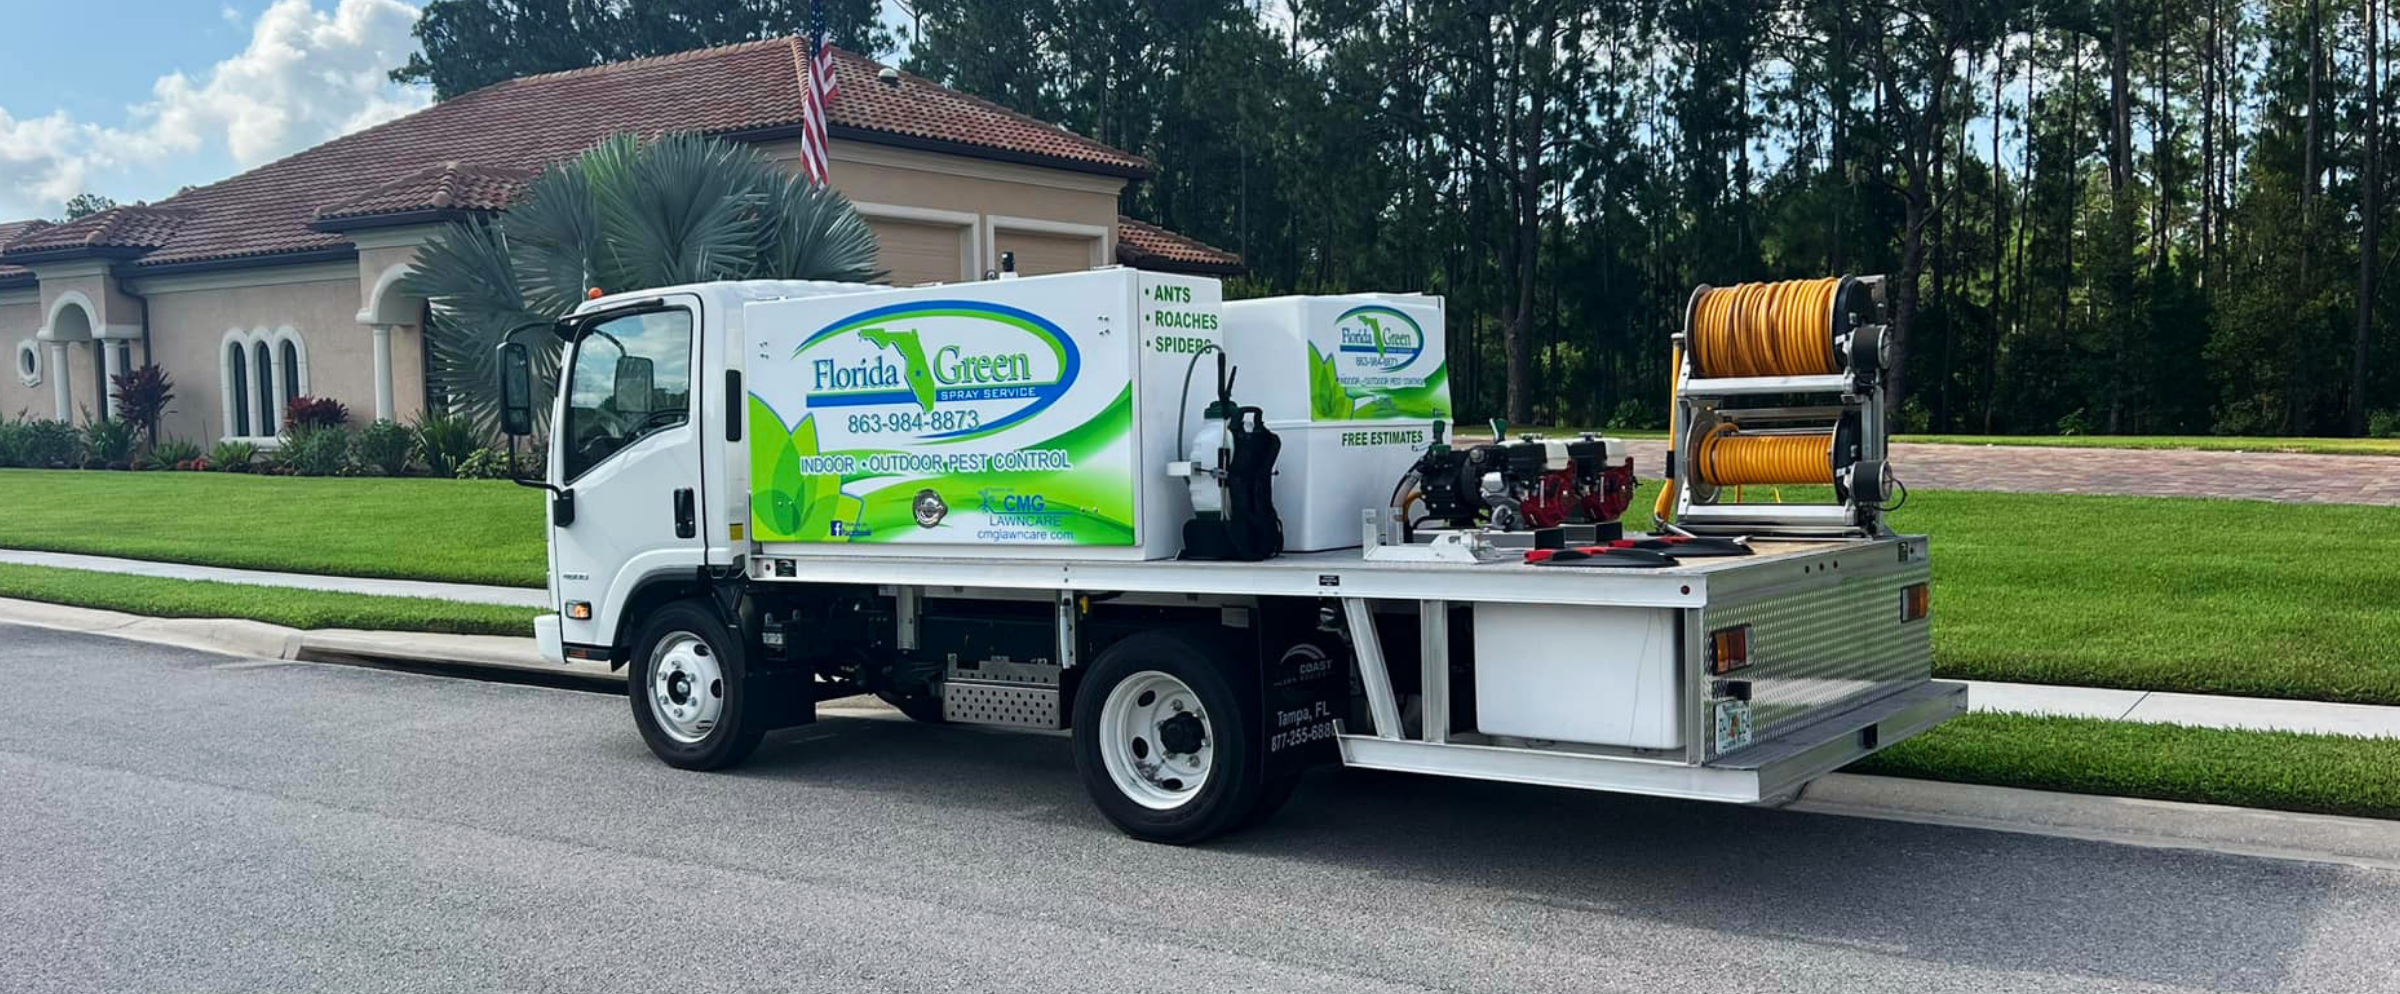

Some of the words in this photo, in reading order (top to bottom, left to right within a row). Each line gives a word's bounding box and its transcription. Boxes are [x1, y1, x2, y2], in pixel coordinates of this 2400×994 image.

[1154, 284, 1191, 303] ANTS
[1155, 310, 1218, 330] ROACHES
[1155, 336, 1212, 354] SPIDERS
[1341, 327, 1373, 343] Florida
[1383, 327, 1411, 345] Green
[812, 355, 900, 390] Florida
[934, 345, 1032, 385] Green
[941, 390, 980, 400] SPRAY
[984, 387, 1036, 399] SERVICE
[848, 409, 981, 433] 863-984-8873
[1341, 432, 1368, 447] FREE
[1370, 430, 1423, 445] ESTIMATES
[801, 455, 855, 473] INDOOR
[869, 453, 944, 472] OUTDOOR
[949, 453, 988, 471] PEST
[993, 451, 1071, 469] CONTROL
[1004, 494, 1045, 511] CMG
[989, 515, 1062, 526] LAWNCARE
[1299, 659, 1333, 674] COAST
[1277, 708, 1312, 727] Tampa,
[1315, 701, 1330, 718] FL
